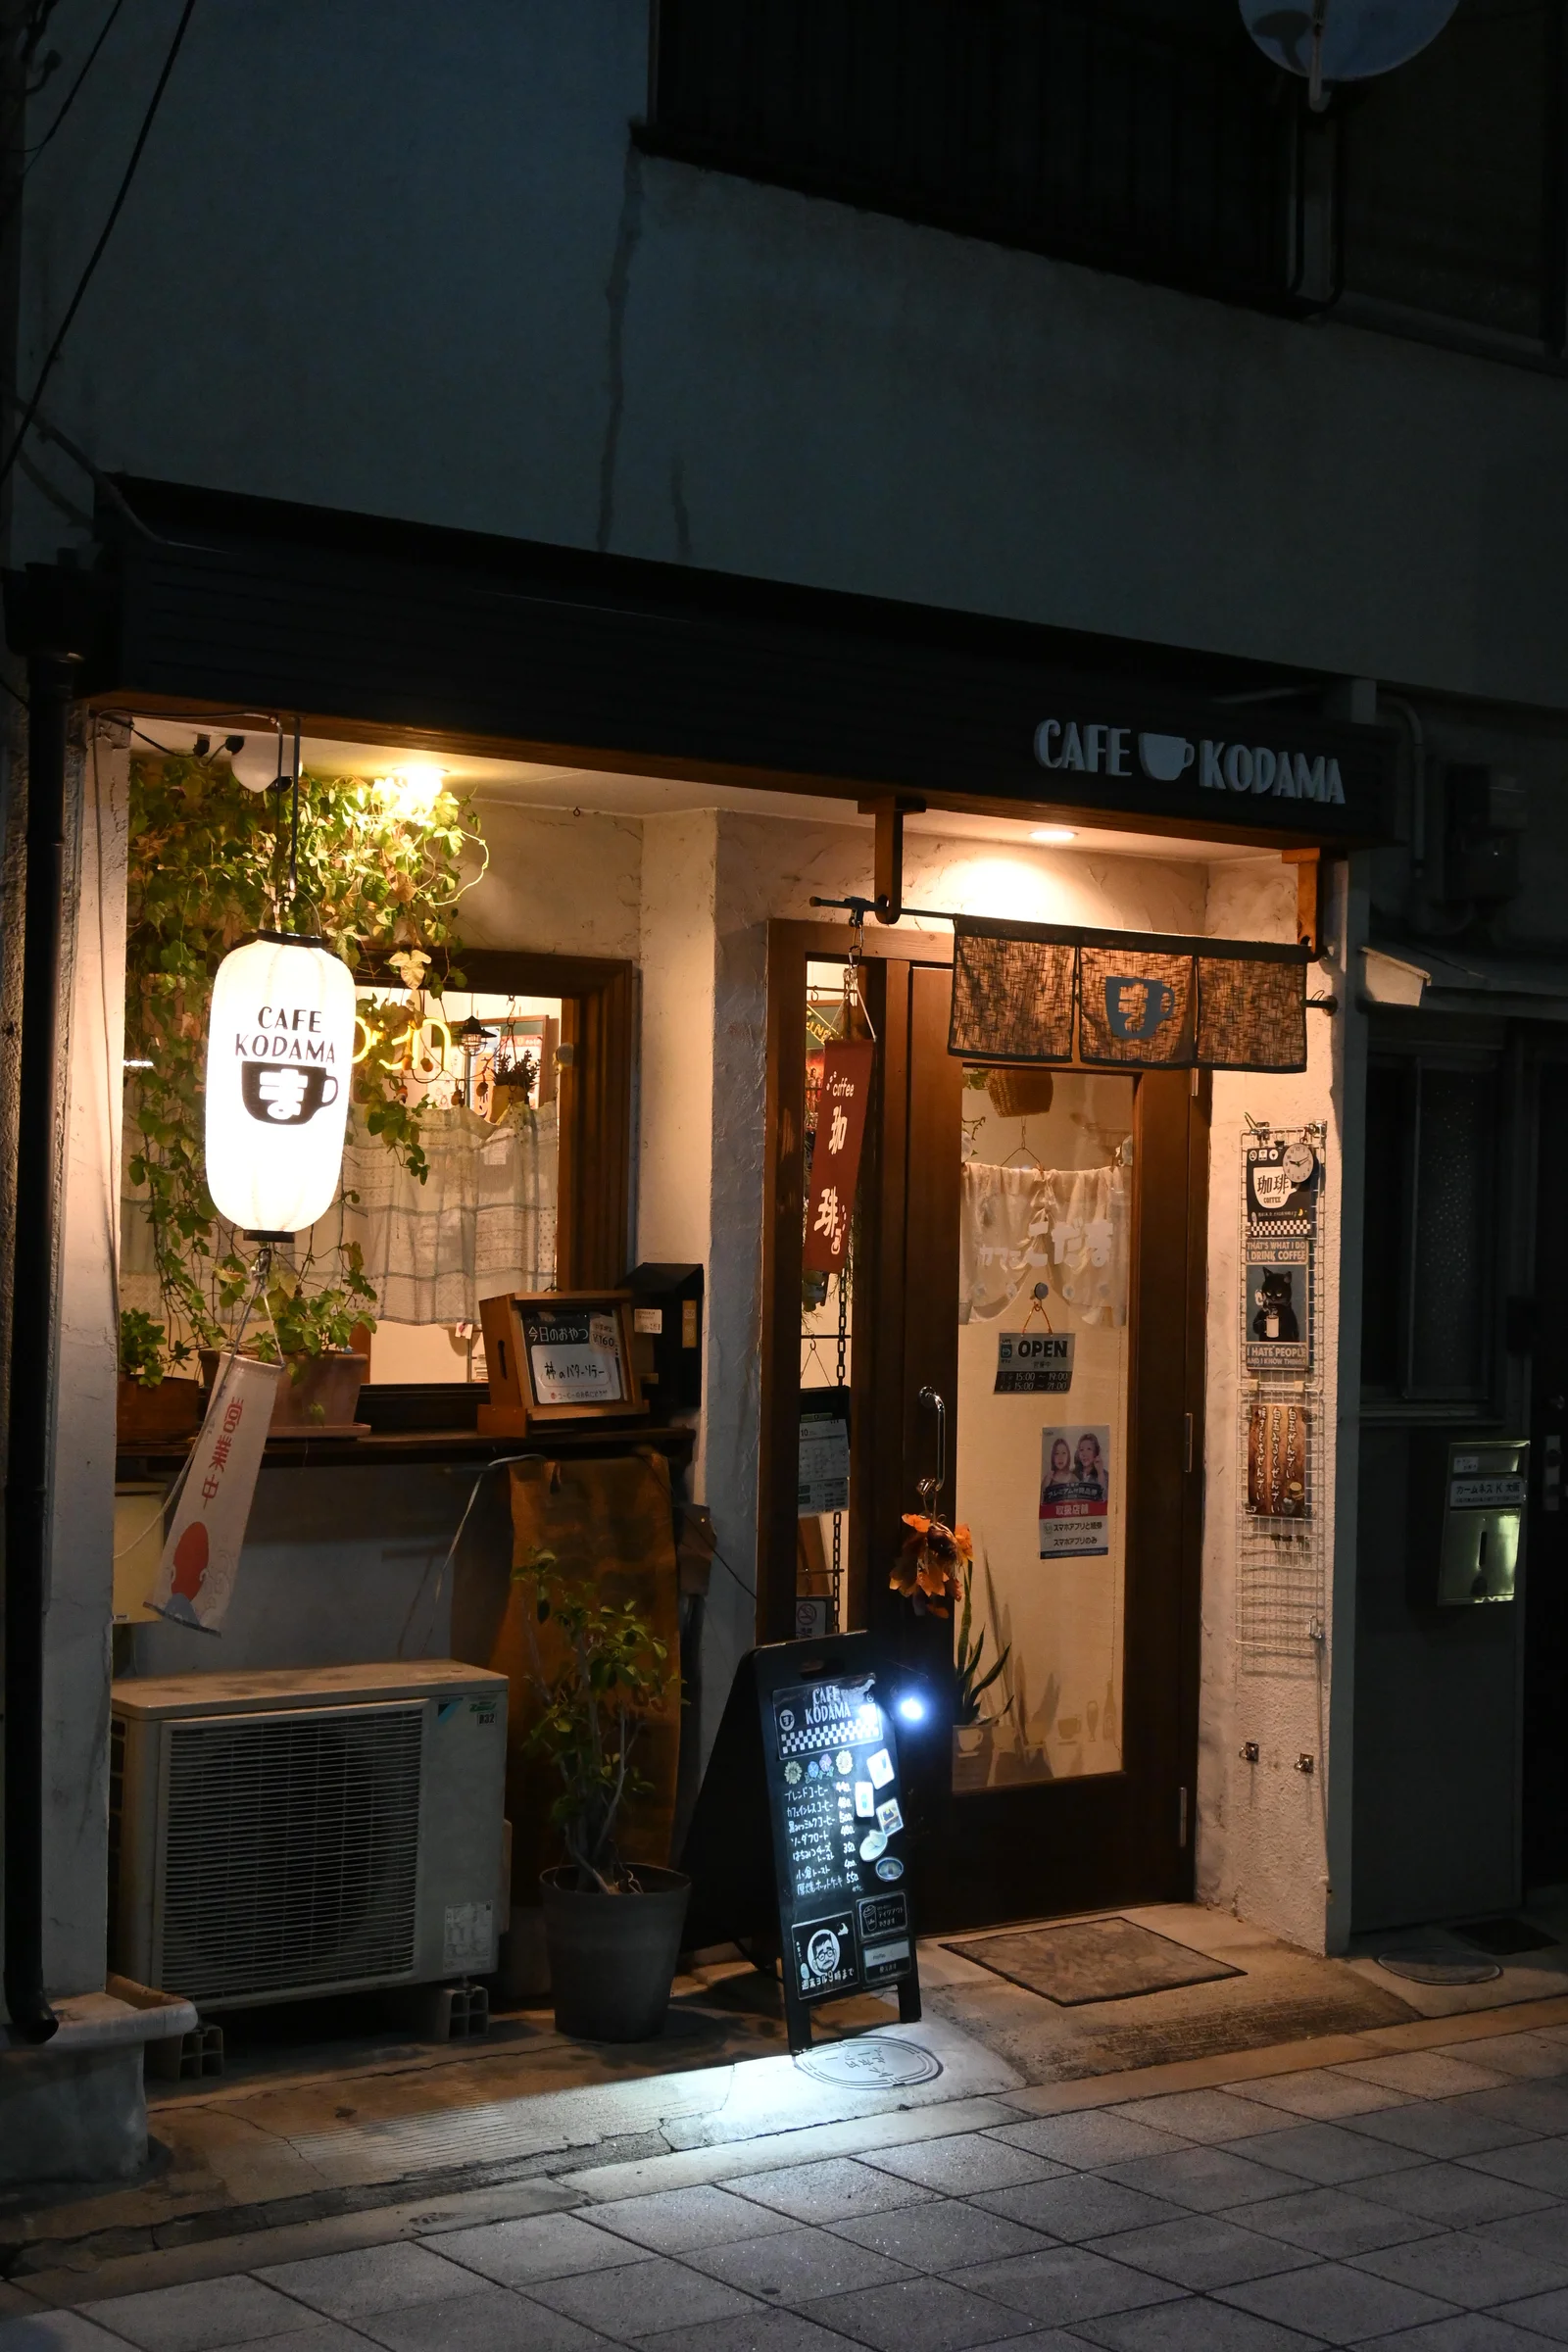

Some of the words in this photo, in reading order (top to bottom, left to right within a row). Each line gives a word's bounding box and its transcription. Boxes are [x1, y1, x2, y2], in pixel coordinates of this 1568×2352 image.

[1034, 718, 1132, 777] CAFE
[1199, 739, 1347, 805] KODAMA
[258, 1006, 323, 1034] CAFE
[235, 1033, 335, 1064] KODAMA
[833, 1077, 855, 1098] coffee
[813, 1104, 848, 1238] 珈琲
[1256, 1174, 1290, 1195] 珈琲
[1250, 1251, 1276, 1260] DRINK
[1278, 1250, 1306, 1260] COFFEE
[1295, 1241, 1305, 1250] DO
[528, 1326, 589, 1343] 今日のおやつ
[1018, 1341, 1068, 1358] OPEN
[1251, 1347, 1274, 1357] HATE
[1275, 1347, 1306, 1357] PEOPLE
[202, 1396, 244, 1510] 営業中
[1286, 1407, 1297, 1479] 白玉ぜんざい
[1054, 1537, 1098, 1546] スマホアプリのみ
[812, 1685, 841, 1705] CAFE
[805, 1701, 852, 1725] KODAMA
[785, 1785, 829, 1801] ブレンドコーヒー
[787, 1799, 834, 1818] カフェインレスコーヒー
[791, 1830, 829, 1846] ソーダフロート
[802, 1968, 855, 1990] 週末ヨル9時まで
